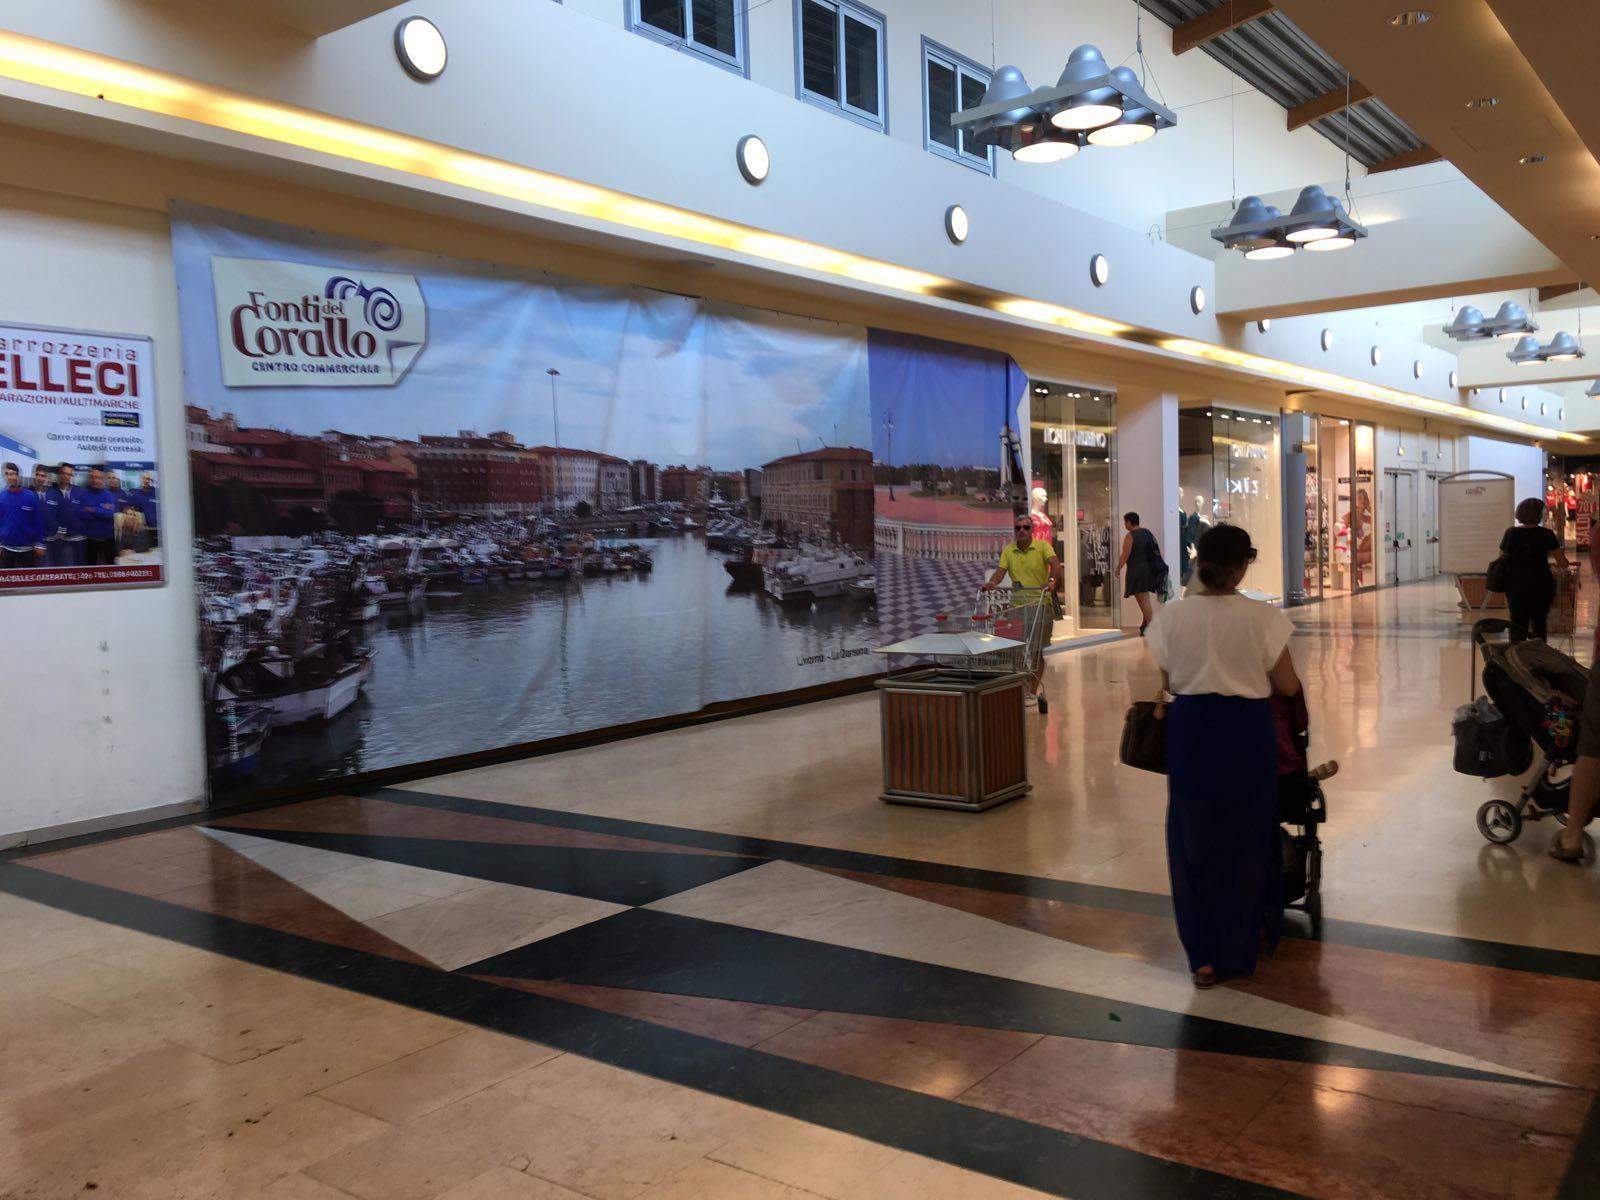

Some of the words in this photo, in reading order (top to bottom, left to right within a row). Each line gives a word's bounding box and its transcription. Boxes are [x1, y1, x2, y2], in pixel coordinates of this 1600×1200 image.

[247, 291, 320, 322] Fonti
[322, 300, 345, 316] del
[230, 304, 377, 359] Corallo
[251, 361, 298, 372] CENTRO
[301, 362, 380, 374] COMMERCIALE
[60, 396, 140, 410] MULTIMARCHE
